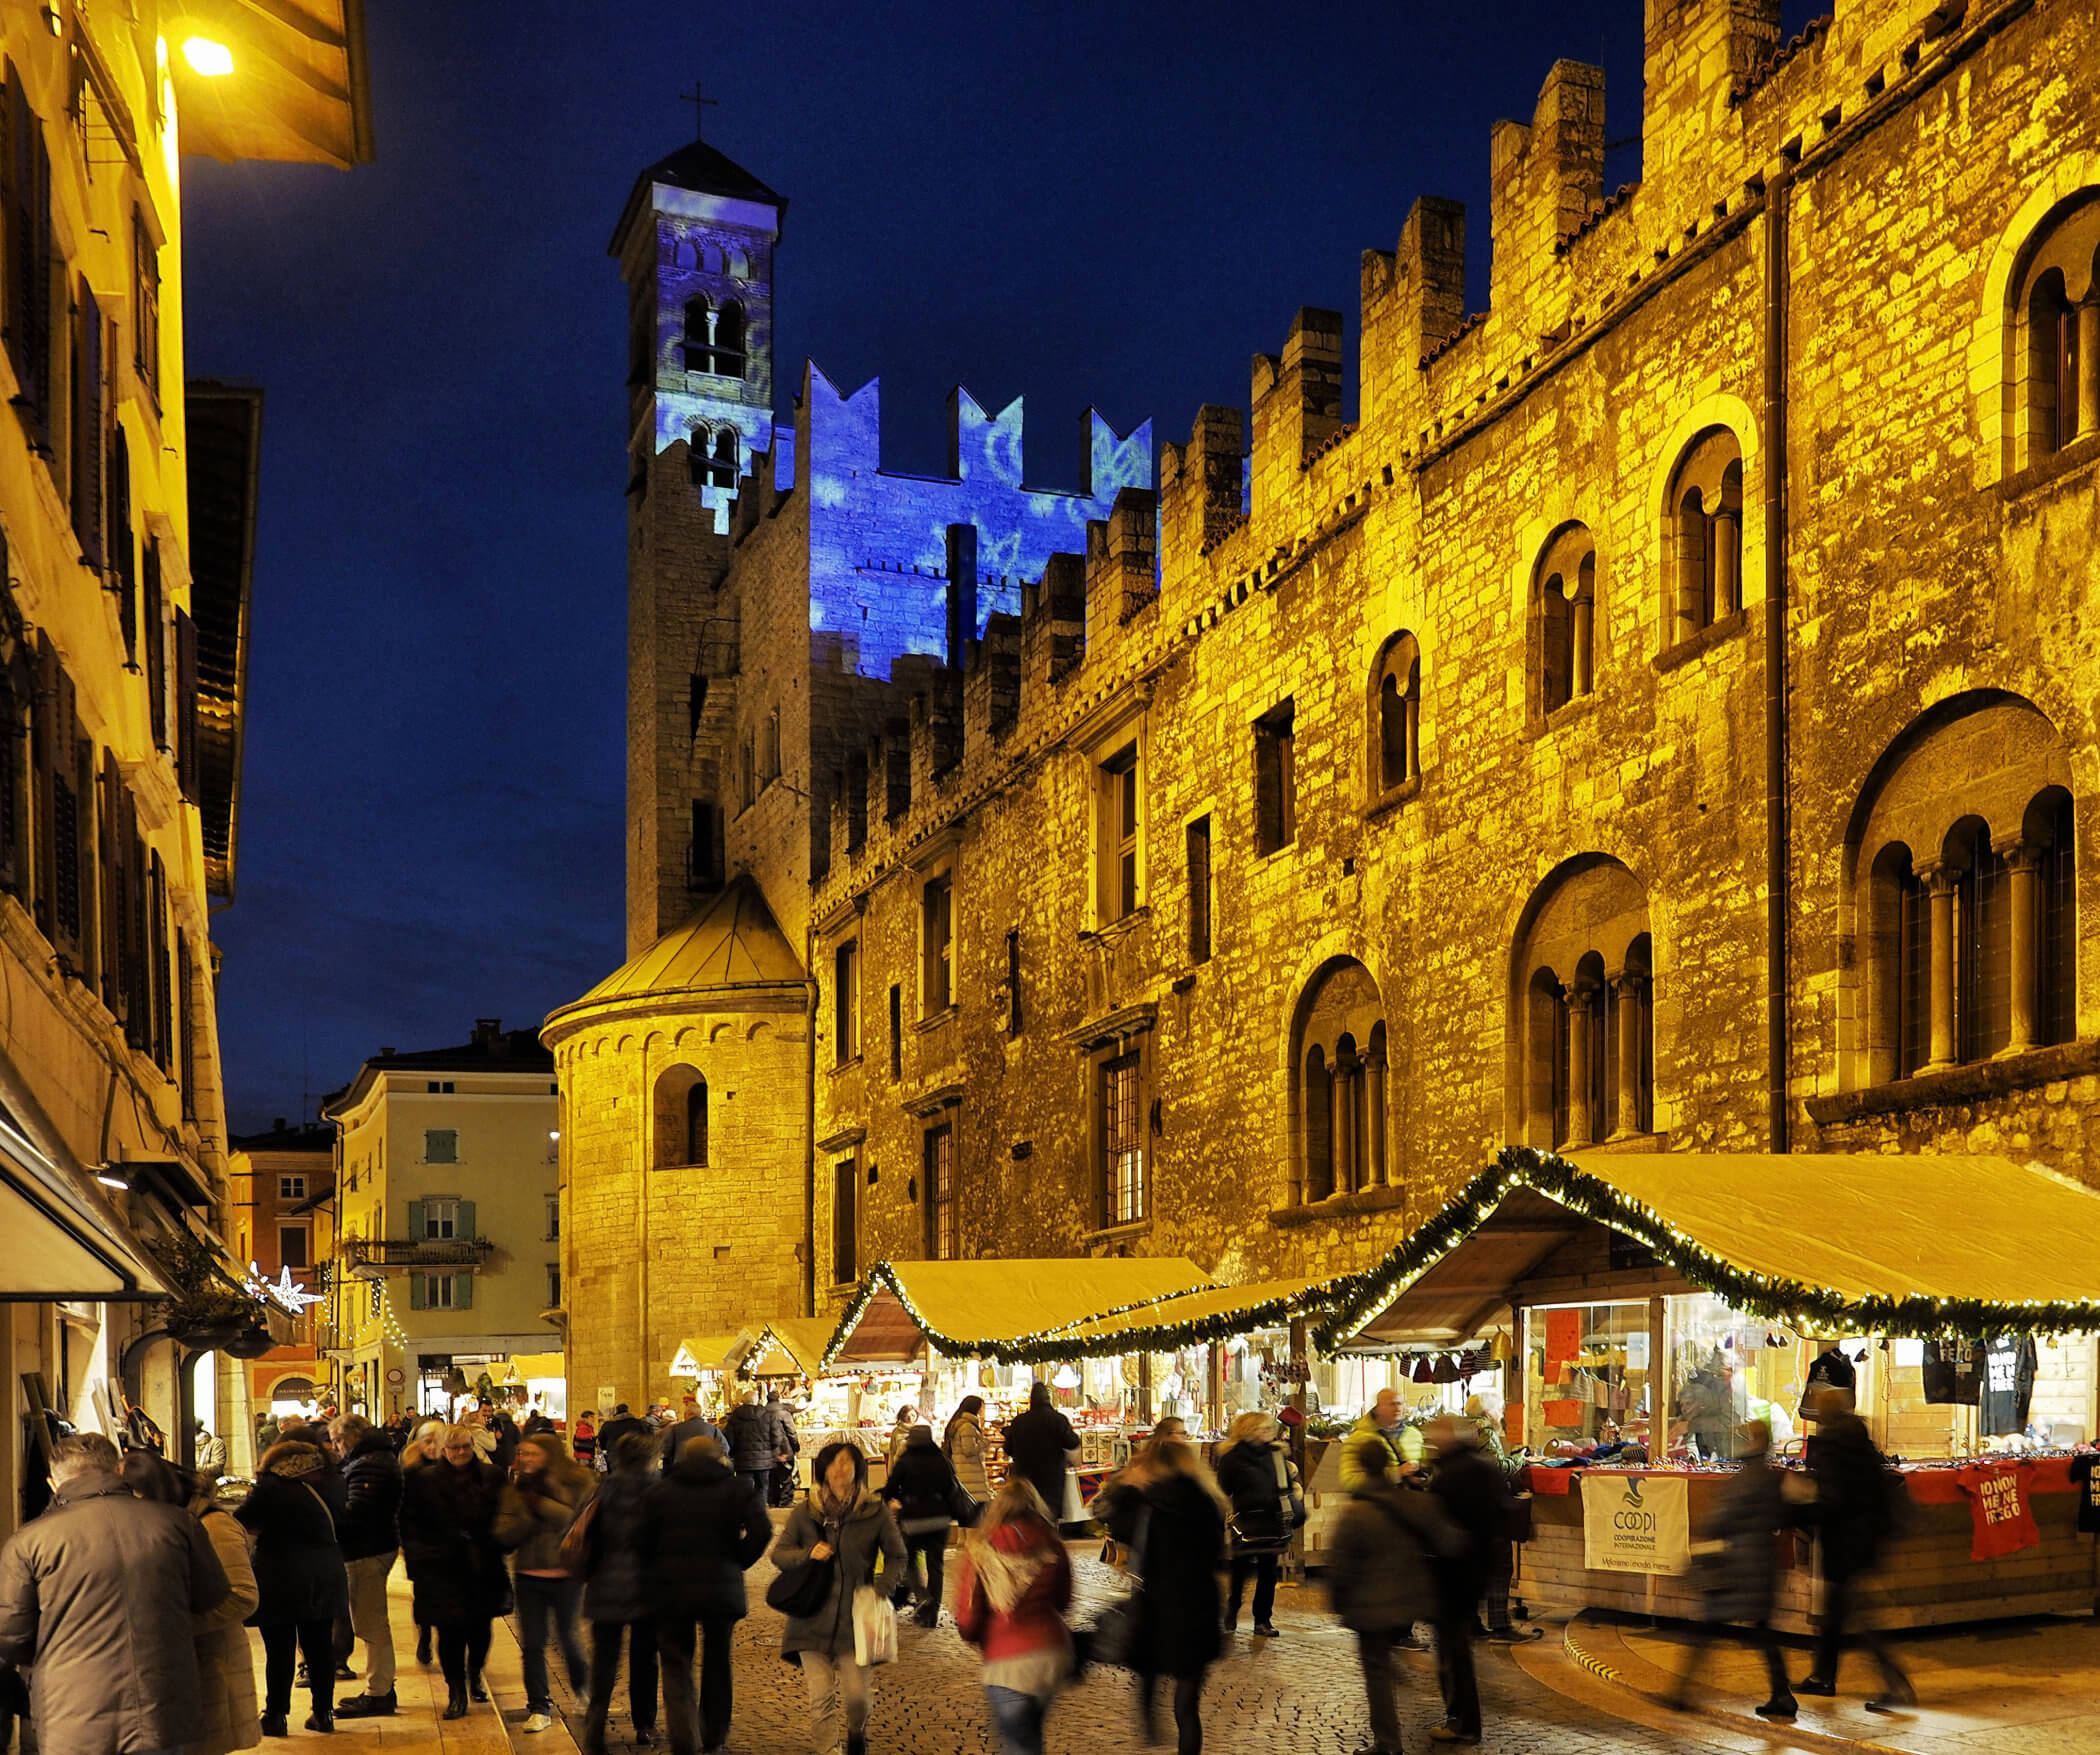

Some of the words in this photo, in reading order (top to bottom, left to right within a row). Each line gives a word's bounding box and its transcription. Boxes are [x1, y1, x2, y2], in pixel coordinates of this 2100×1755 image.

[1989, 1378, 2014, 1392] FREG
[1980, 1480, 1993, 1497] IO
[1993, 1474, 2017, 1493] NON
[1983, 1494, 2000, 1511] ME
[2003, 1488, 2018, 1504] NE
[1614, 1511, 1656, 1534] COOPI
[1986, 1503, 2020, 1526] FREGO
